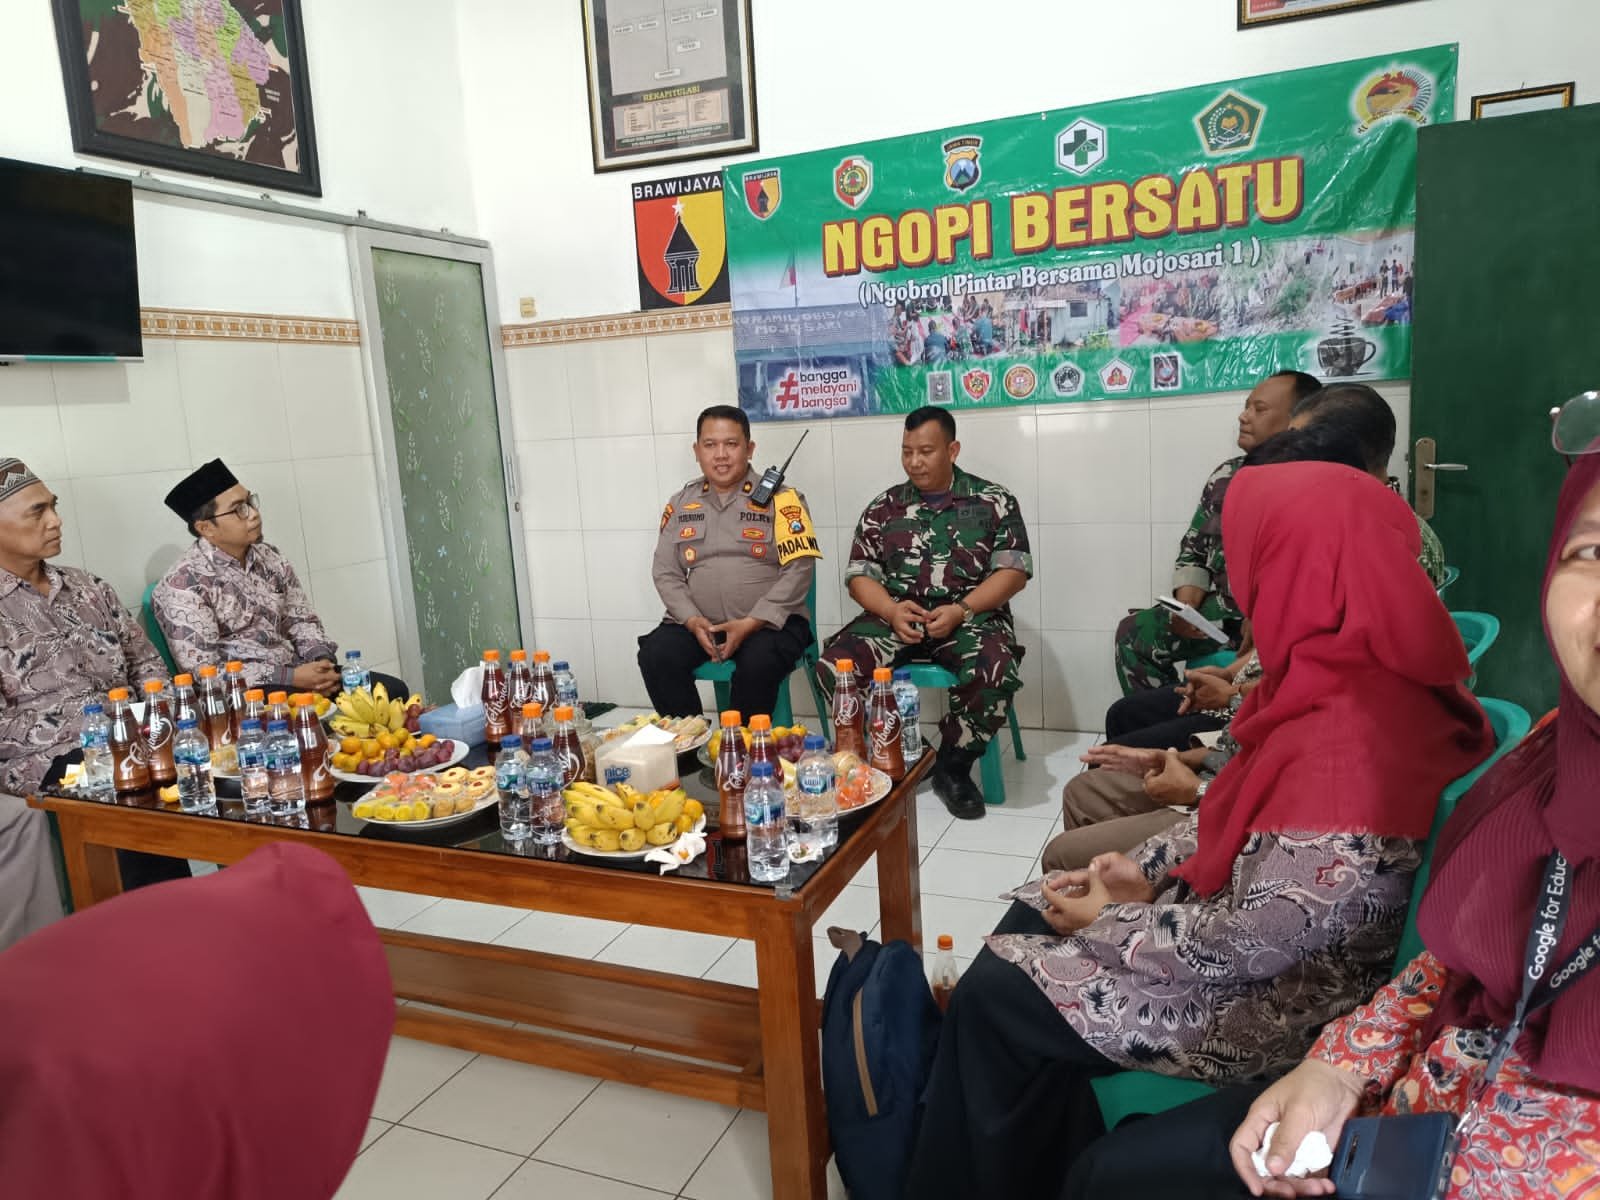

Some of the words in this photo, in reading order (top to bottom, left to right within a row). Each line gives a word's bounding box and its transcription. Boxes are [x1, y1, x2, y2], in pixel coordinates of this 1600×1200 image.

[634, 175, 722, 199] BRAWIJAYA
[822, 200, 992, 277] NGOPI
[1011, 156, 1304, 255] BERSATU
[952, 271, 1017, 296] Pintar
[1020, 261, 1117, 285] Bersama
[1121, 242, 1223, 279] Mojosari
[799, 369, 847, 384] bangga
[801, 380, 857, 397] melayani
[802, 395, 847, 409] bangsa
[777, 536, 808, 560] PADAL
[1541, 898, 1561, 920] for
[1528, 923, 1557, 980] Google
[1550, 946, 1596, 988] Google
